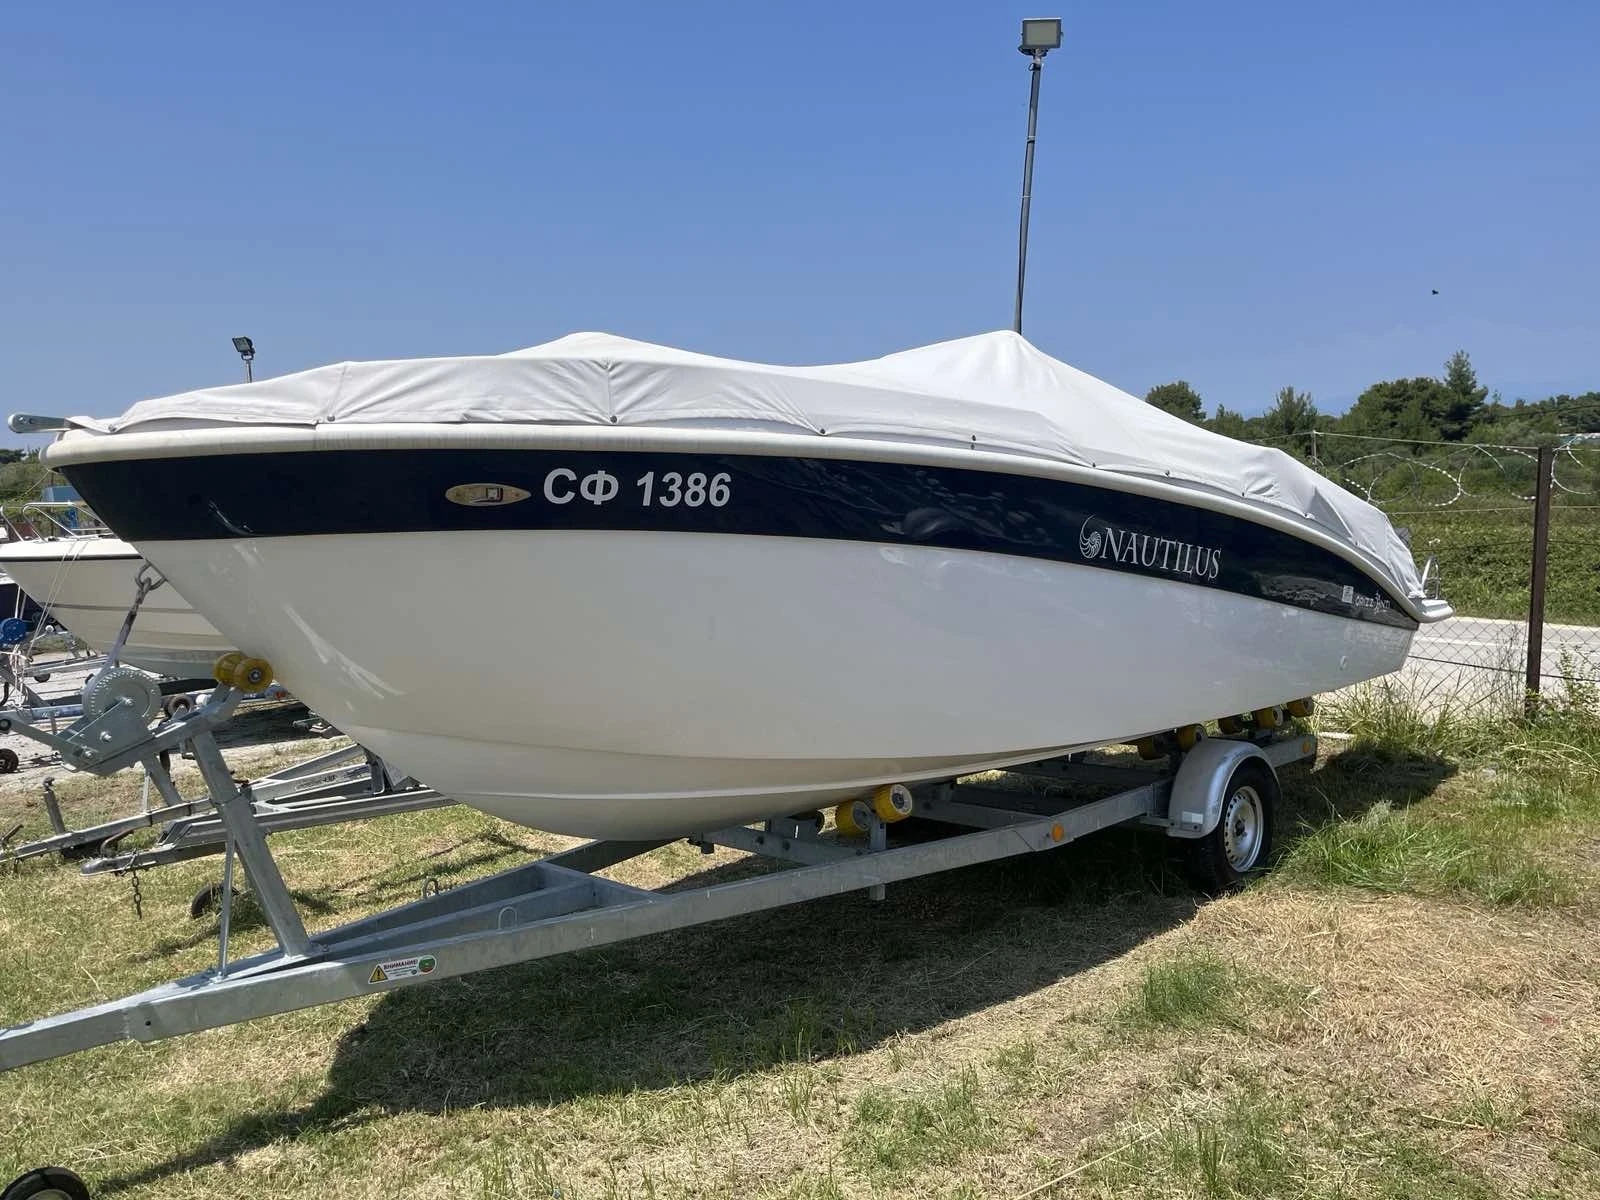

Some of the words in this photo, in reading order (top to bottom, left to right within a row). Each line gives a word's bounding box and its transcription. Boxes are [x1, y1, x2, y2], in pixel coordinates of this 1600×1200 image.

[543, 468, 619, 505] СФ
[636, 471, 732, 507] 1386
[1100, 527, 1222, 580] NAUTILUS
